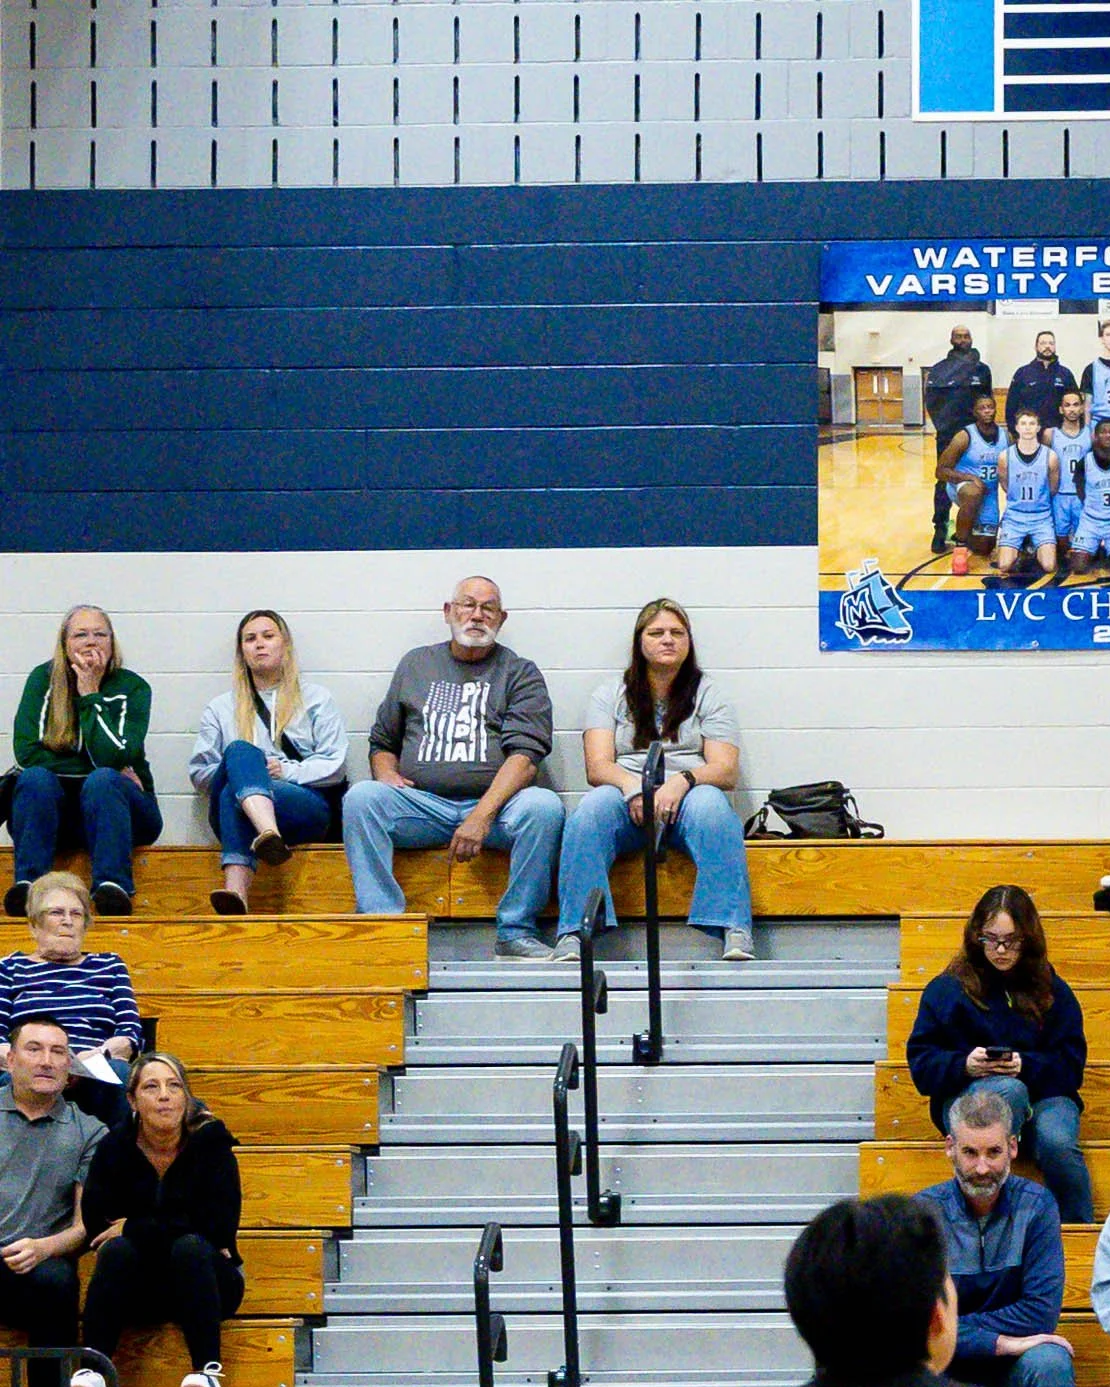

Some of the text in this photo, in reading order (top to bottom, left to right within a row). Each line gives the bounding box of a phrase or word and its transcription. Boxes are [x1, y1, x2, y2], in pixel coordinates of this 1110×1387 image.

[865, 273, 1067, 296] VARSITY
[980, 466, 997, 480] 32
[1070, 459, 1078, 474] 0
[1021, 486, 1033, 500] 11
[975, 592, 1046, 622] LVC
[450, 682, 476, 762] PAPA
